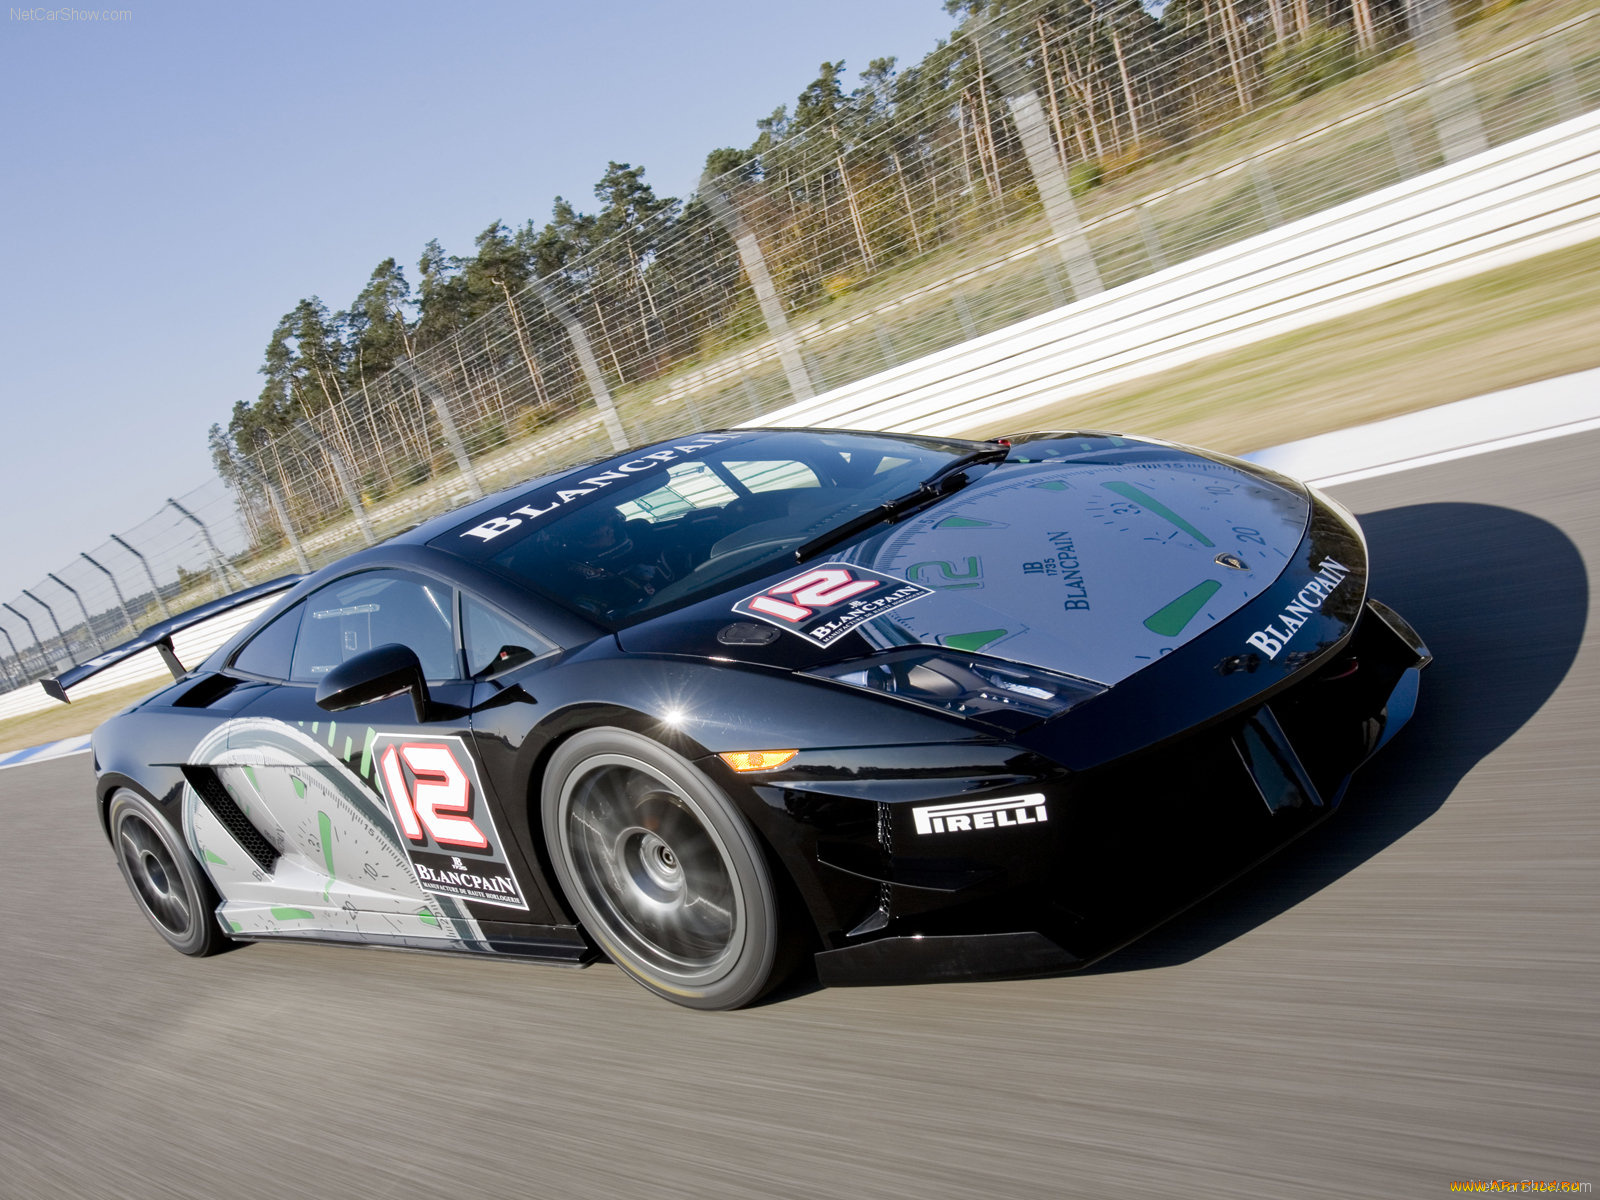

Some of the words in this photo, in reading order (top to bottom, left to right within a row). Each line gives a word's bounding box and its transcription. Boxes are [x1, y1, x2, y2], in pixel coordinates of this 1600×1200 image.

[1043, 557, 1058, 576] 1735
[1047, 531, 1090, 611] BLANCPAIN
[748, 569, 880, 623] 12
[809, 585, 920, 639] BLANCPAIN
[1245, 555, 1351, 660] BLANCPAIN
[380, 742, 488, 849] 12
[912, 792, 1048, 835] PIRELLI
[414, 863, 516, 895] BLANCPAIN
